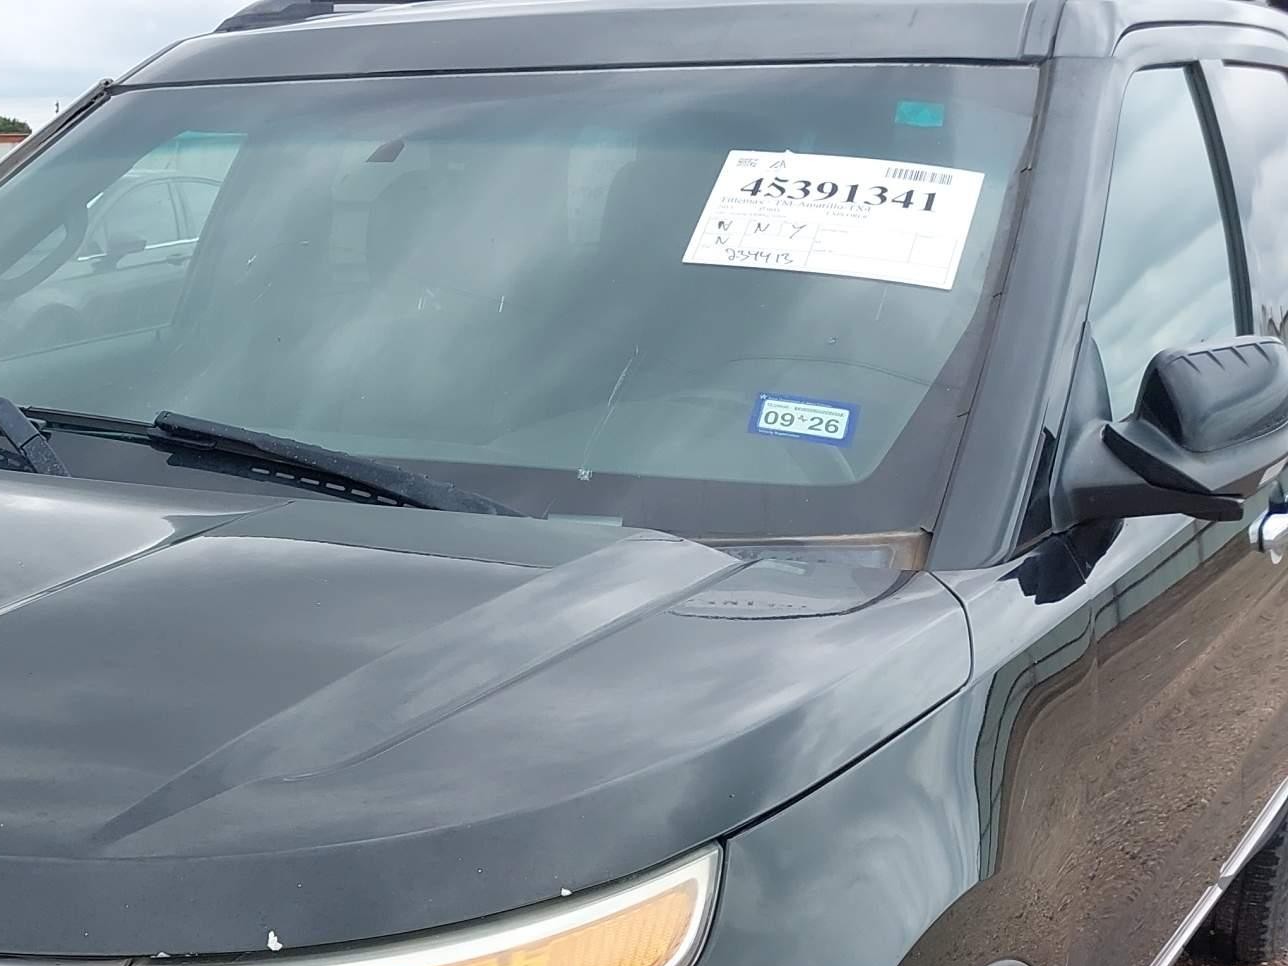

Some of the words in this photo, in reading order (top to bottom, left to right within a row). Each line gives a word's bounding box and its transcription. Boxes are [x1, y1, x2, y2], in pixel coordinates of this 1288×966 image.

[740, 176, 937, 212] 45391341
[763, 410, 795, 428] 09
[807, 416, 840, 434] 26
